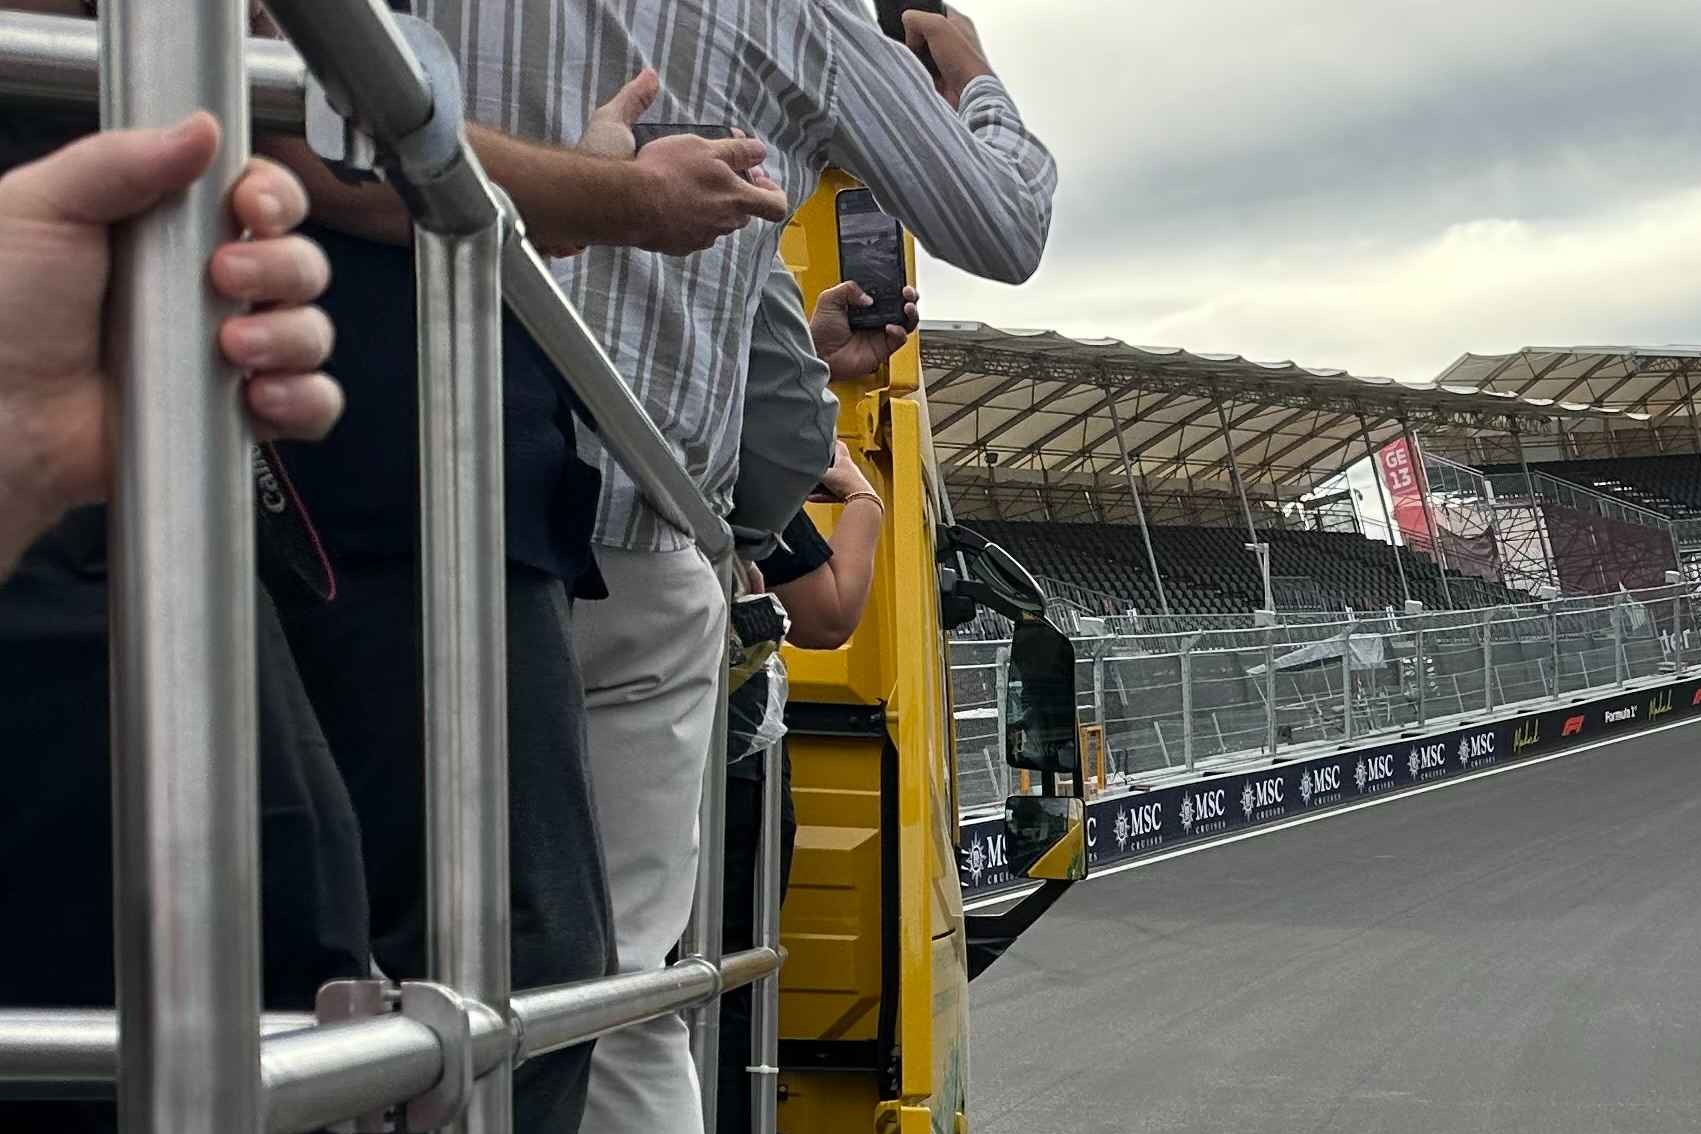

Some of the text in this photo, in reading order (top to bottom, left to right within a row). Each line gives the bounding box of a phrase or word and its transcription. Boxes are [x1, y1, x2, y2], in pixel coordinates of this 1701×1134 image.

[1386, 448, 1408, 468] GE
[1390, 467, 1412, 490] 13
[1605, 707, 1630, 724] Formula
[1421, 743, 1446, 769] MSC
[1471, 732, 1495, 756] MSC
[1313, 765, 1341, 793] MSC
[1368, 754, 1394, 781] MSC
[1195, 789, 1226, 821] MSC
[1256, 777, 1284, 807] MSC
[1130, 802, 1163, 837] MSC
